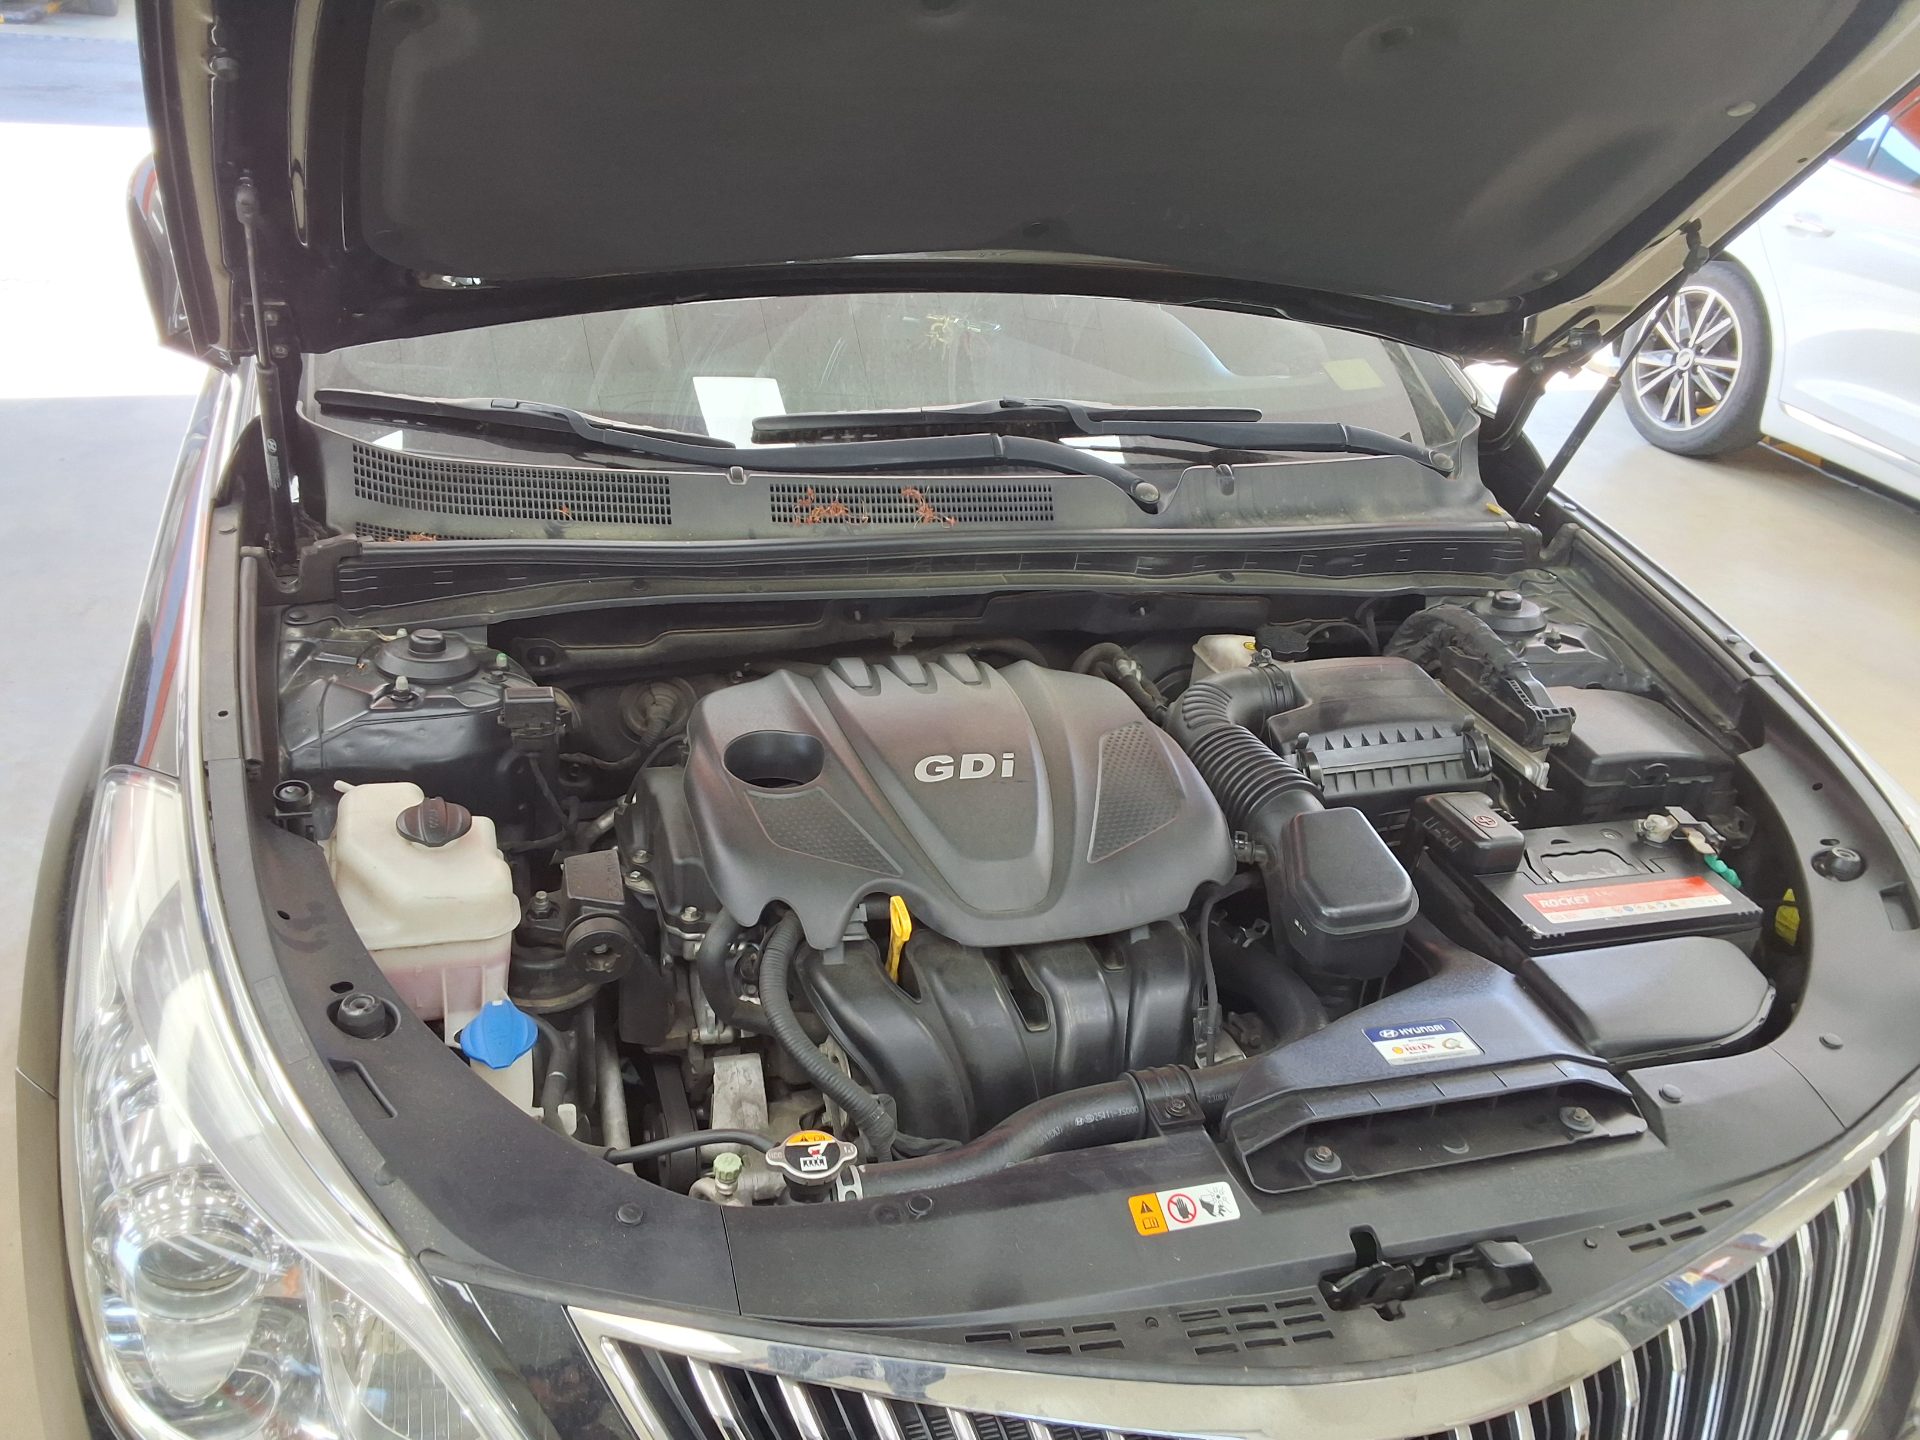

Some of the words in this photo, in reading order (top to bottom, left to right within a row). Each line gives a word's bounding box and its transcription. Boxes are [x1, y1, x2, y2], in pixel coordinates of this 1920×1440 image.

[914, 752, 1015, 783] GDi
[1539, 895, 1590, 908] ROCKET
[1398, 1024, 1446, 1036] HYUNDAI
